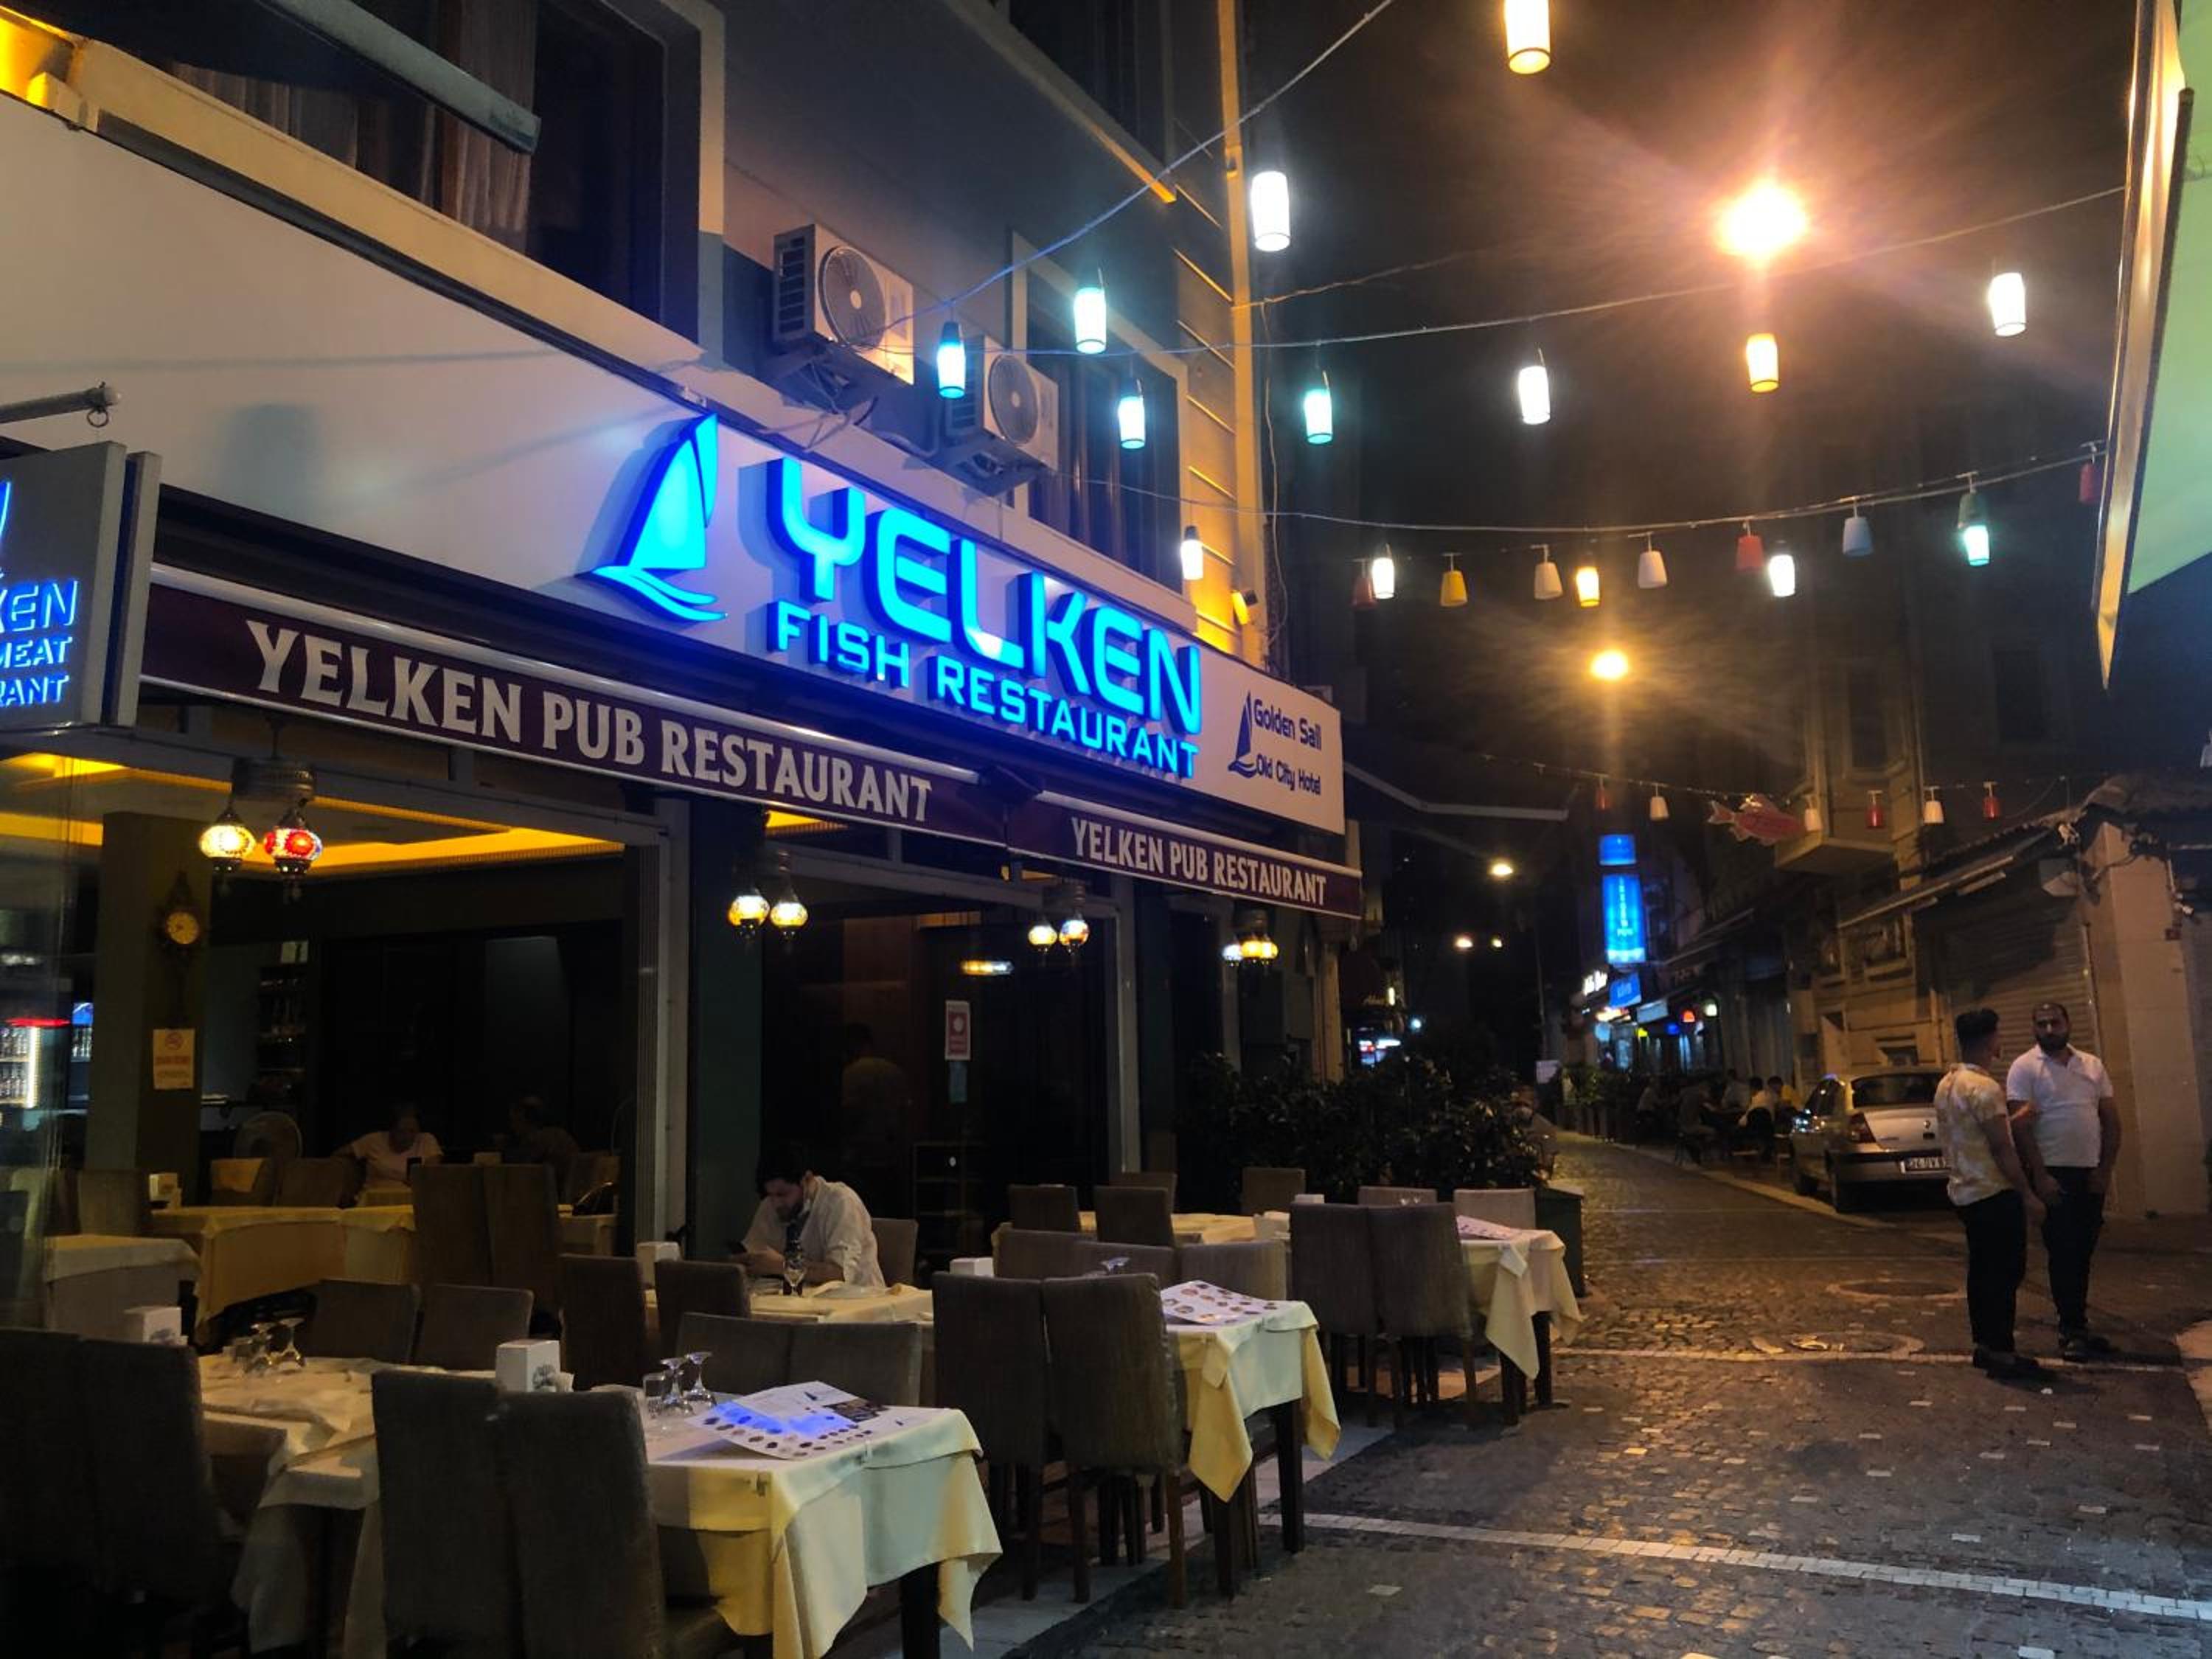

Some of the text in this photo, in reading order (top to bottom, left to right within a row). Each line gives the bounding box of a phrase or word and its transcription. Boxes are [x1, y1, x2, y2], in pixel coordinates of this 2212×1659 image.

[767, 457, 1201, 735] YELKEN
[246, 620, 932, 822] YELKEN PUB RESTAURANT
[768, 600, 1200, 779] FISH RESTAURANT
[1253, 699, 1322, 751] Golden Sail
[1256, 754, 1321, 796] Old City Hotel
[1071, 817, 1326, 905] YELKEN PUB RESTAURANT
